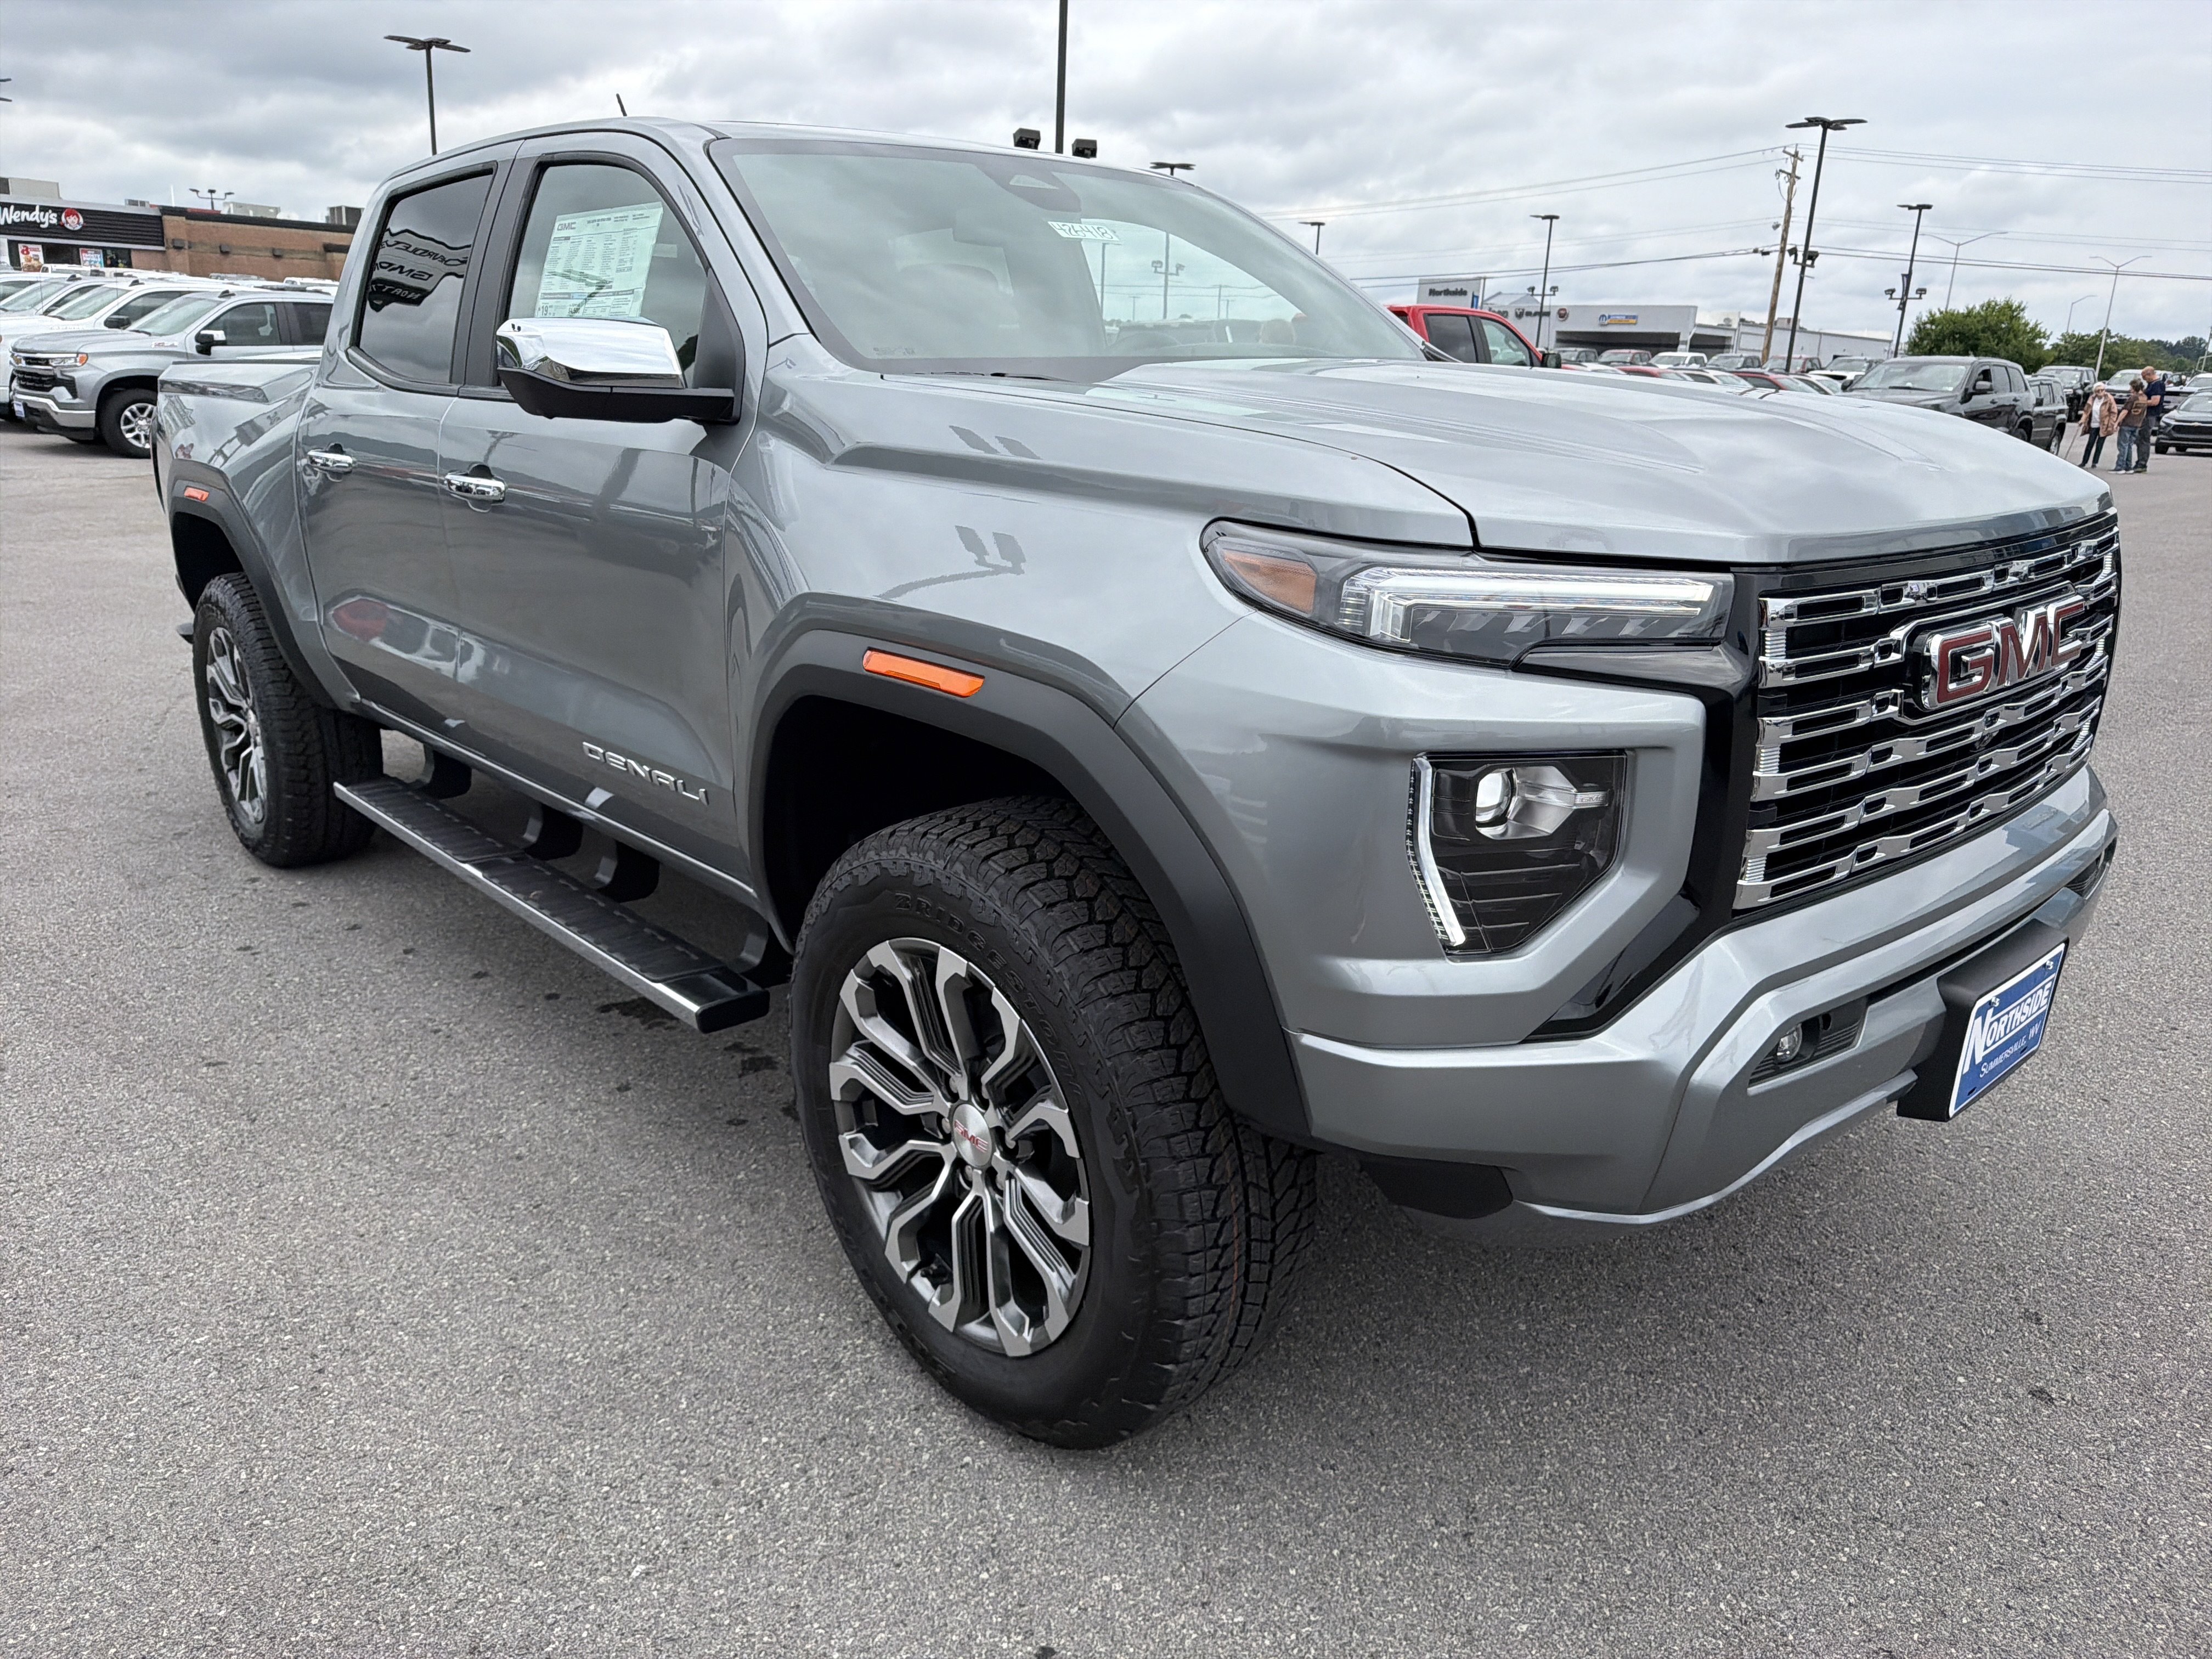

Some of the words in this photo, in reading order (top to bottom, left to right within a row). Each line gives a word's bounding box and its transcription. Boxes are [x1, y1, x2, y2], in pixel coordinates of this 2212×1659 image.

[0, 205, 58, 228] Wendy's
[556, 221, 577, 232] GMC
[1050, 223, 1114, 239] 426418
[1931, 594, 2085, 708] GMC
[582, 741, 710, 806] DENALI
[1581, 794, 1606, 803] GMC
[1962, 980, 2052, 1075] NORTHSIDE
[2028, 1020, 2041, 1040] WV
[953, 1119, 989, 1153] GMC
